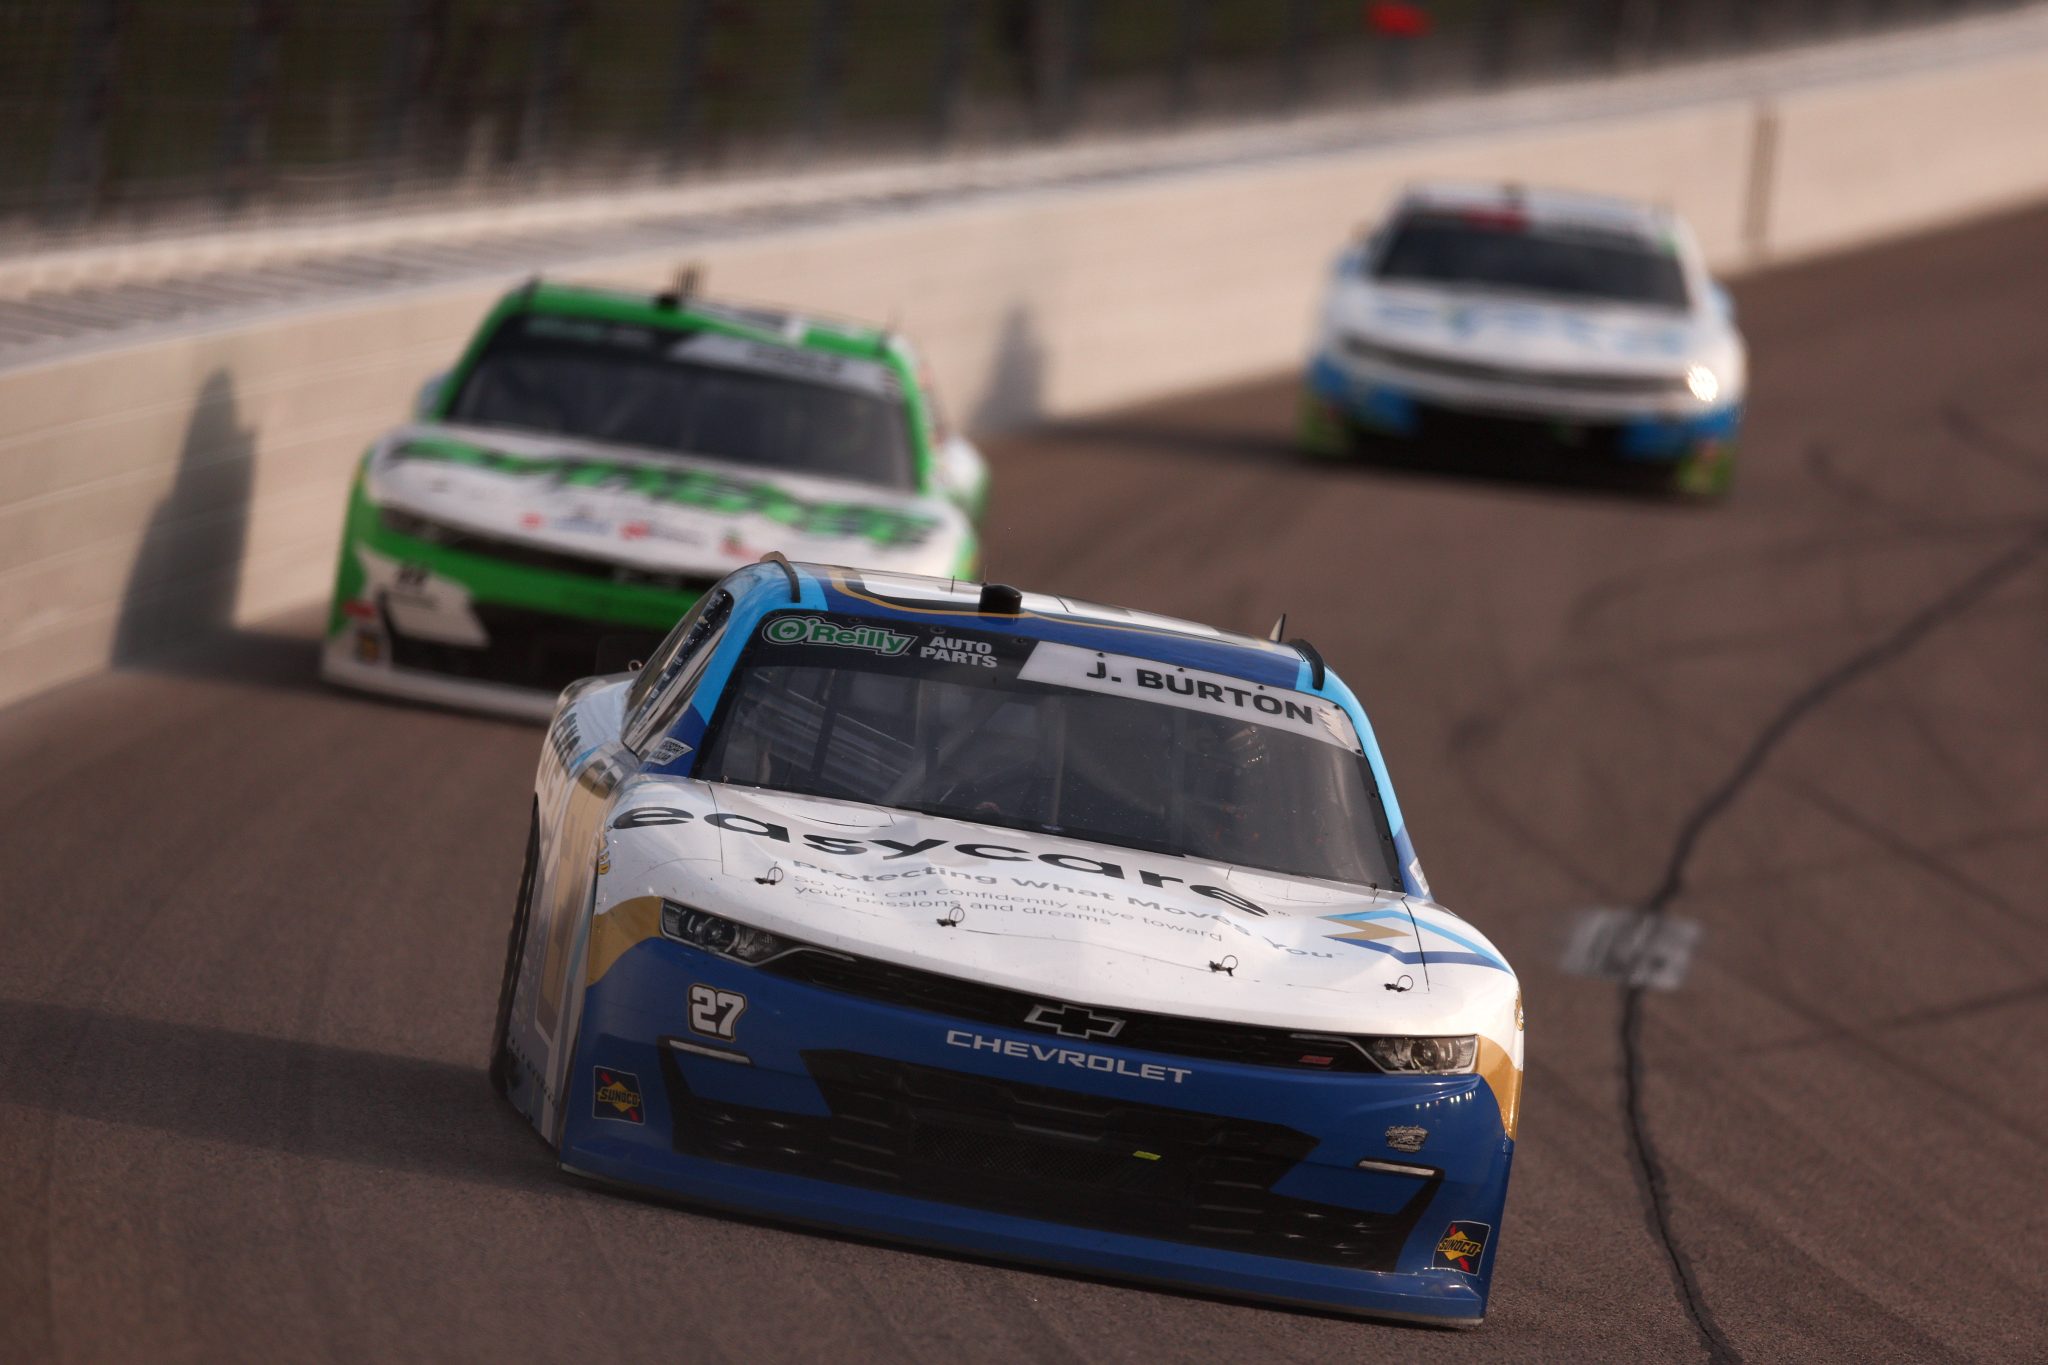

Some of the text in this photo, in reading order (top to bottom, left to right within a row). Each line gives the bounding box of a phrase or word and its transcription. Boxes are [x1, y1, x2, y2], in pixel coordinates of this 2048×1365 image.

[767, 618, 909, 655] O'Reilly
[920, 646, 998, 668] PARTS
[929, 636, 992, 655] AUTO
[1086, 661, 1314, 725] J. BURTON
[613, 806, 1270, 918] easycare
[795, 886, 1112, 926] your passions and dreams
[885, 889, 927, 898] can
[936, 888, 1069, 908] confidently
[1076, 903, 1135, 920] drive
[1143, 916, 1223, 942] toward
[1011, 877, 1115, 901] What
[1127, 896, 1252, 937] Moves
[690, 983, 746, 1039] 27
[946, 1029, 1193, 1084] CHEVROLET
[599, 1086, 639, 1107] SUNOCO
[1438, 1239, 1479, 1256] SUNOCO
